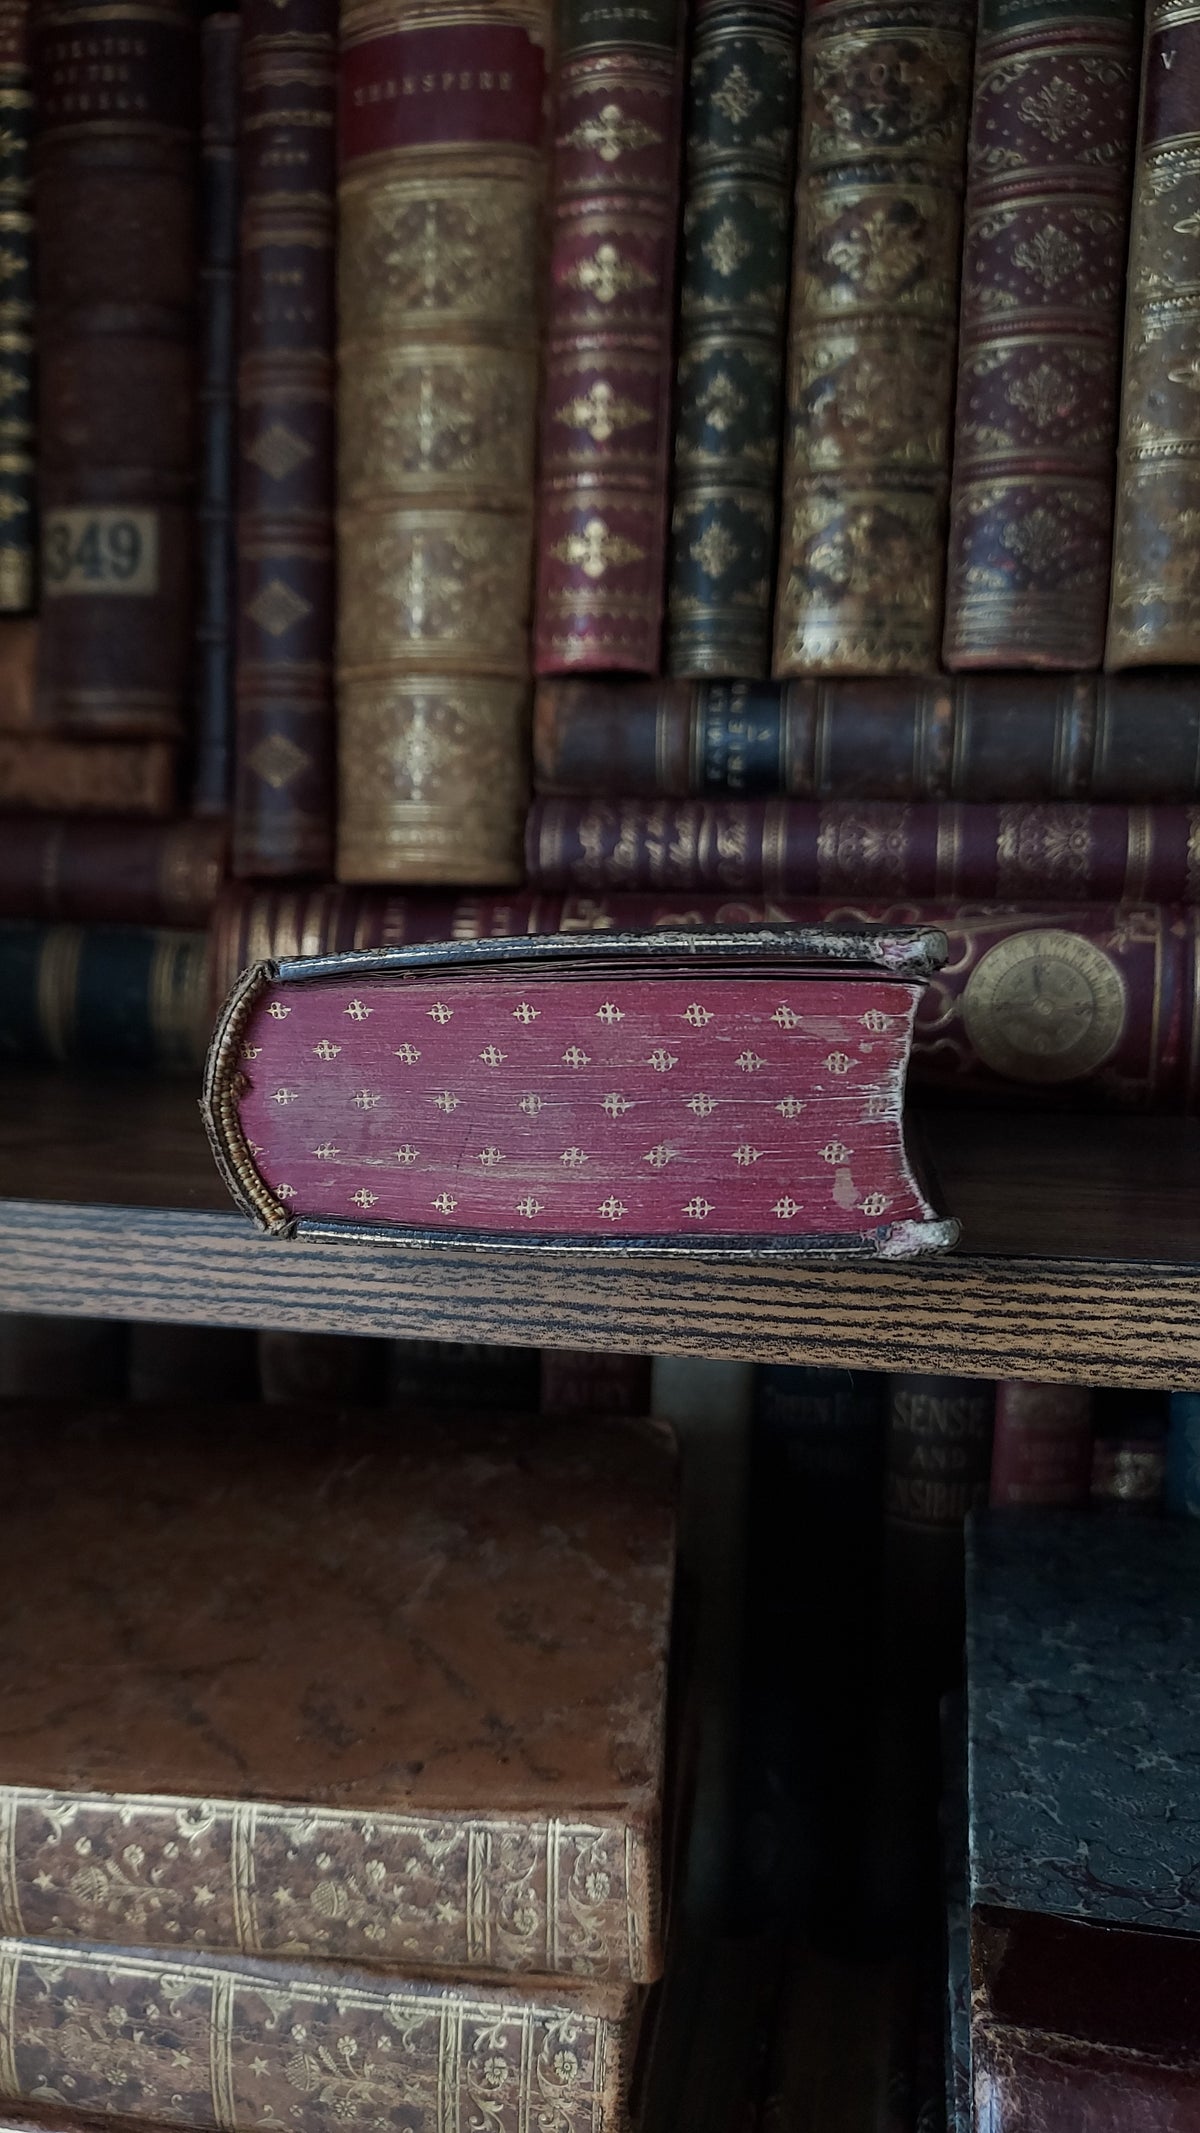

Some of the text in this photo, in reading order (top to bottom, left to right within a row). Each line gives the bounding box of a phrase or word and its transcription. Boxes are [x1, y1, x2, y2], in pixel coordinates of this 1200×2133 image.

[45, 521, 142, 582] 349
[892, 1391, 985, 1439] SENSE
[909, 1444, 967, 1470] AND
